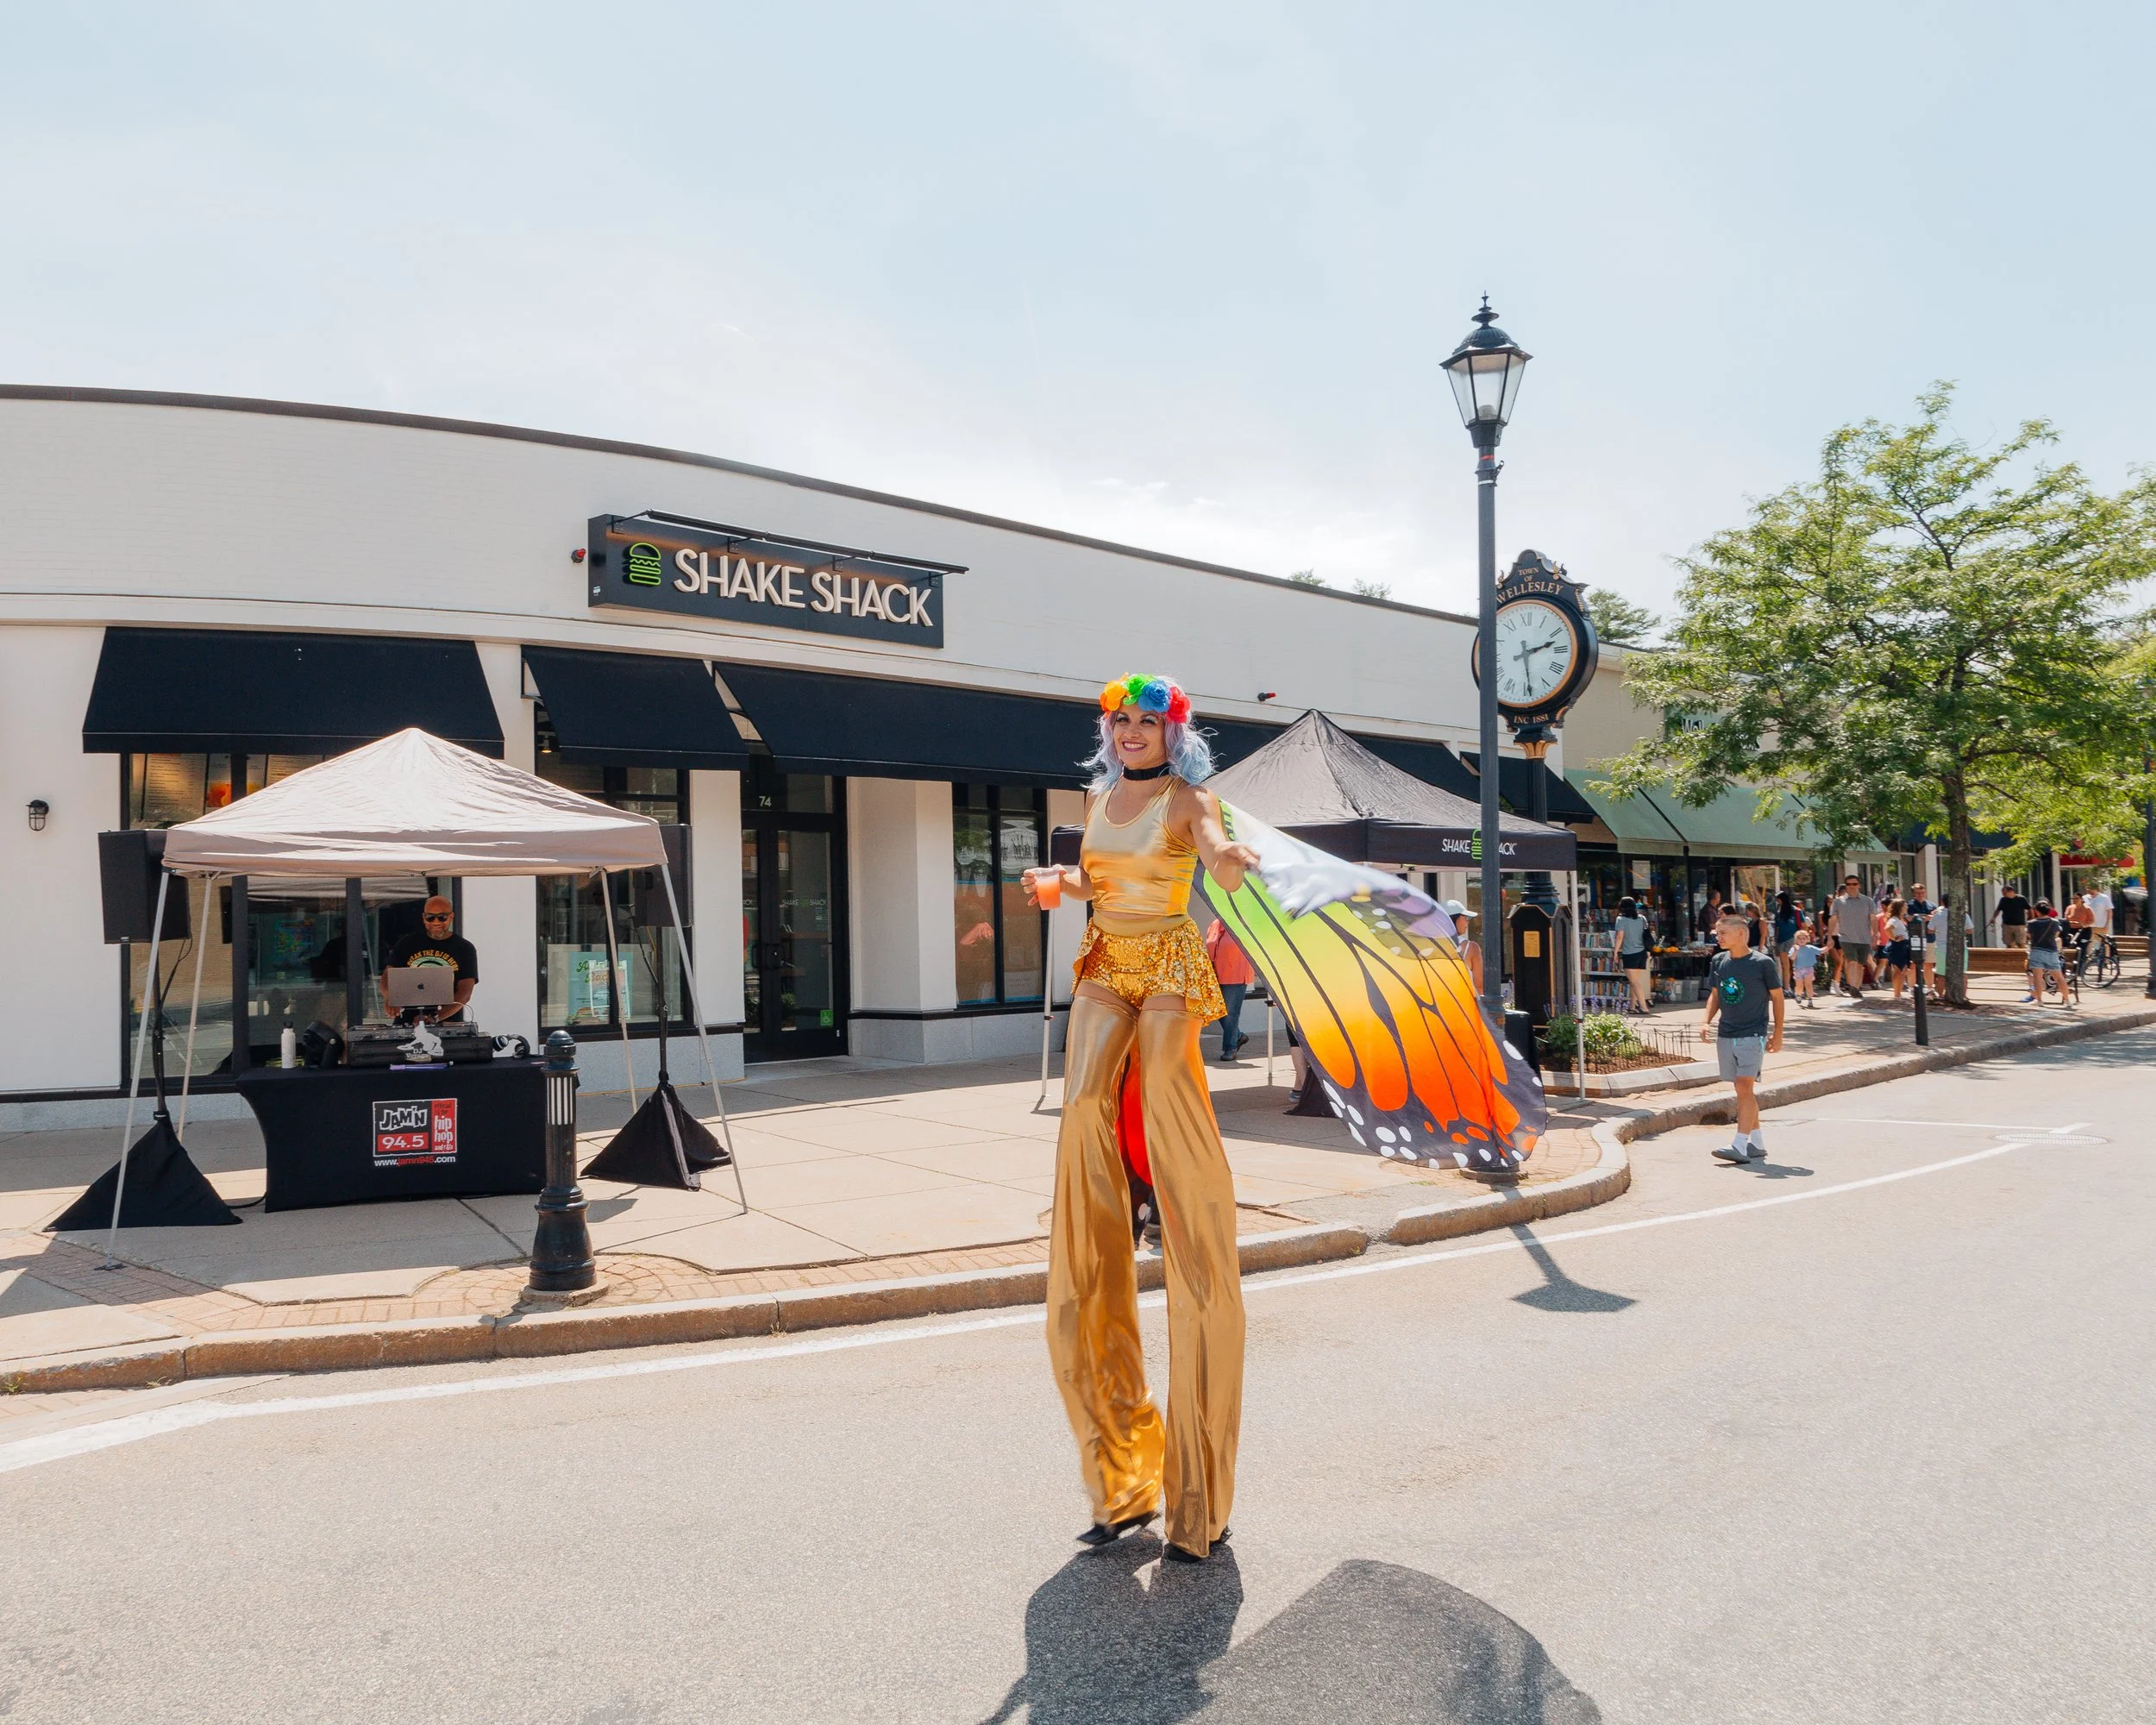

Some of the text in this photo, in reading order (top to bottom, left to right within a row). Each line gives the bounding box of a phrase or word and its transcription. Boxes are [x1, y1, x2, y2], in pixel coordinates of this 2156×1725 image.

[673, 547, 935, 627] SHAKE SHACK
[1496, 581, 1564, 604] WELLESLEY
[1514, 713, 1550, 724] INC 1881
[758, 795, 772, 807] 74
[1441, 838, 1517, 855] SHAKE ACK
[379, 1106, 429, 1131] JAM'N
[434, 1115, 452, 1132] hip
[382, 1135, 424, 1149] 94.5
[434, 1130, 454, 1144] hop
[373, 1156, 457, 1167] www.jamn945.com
